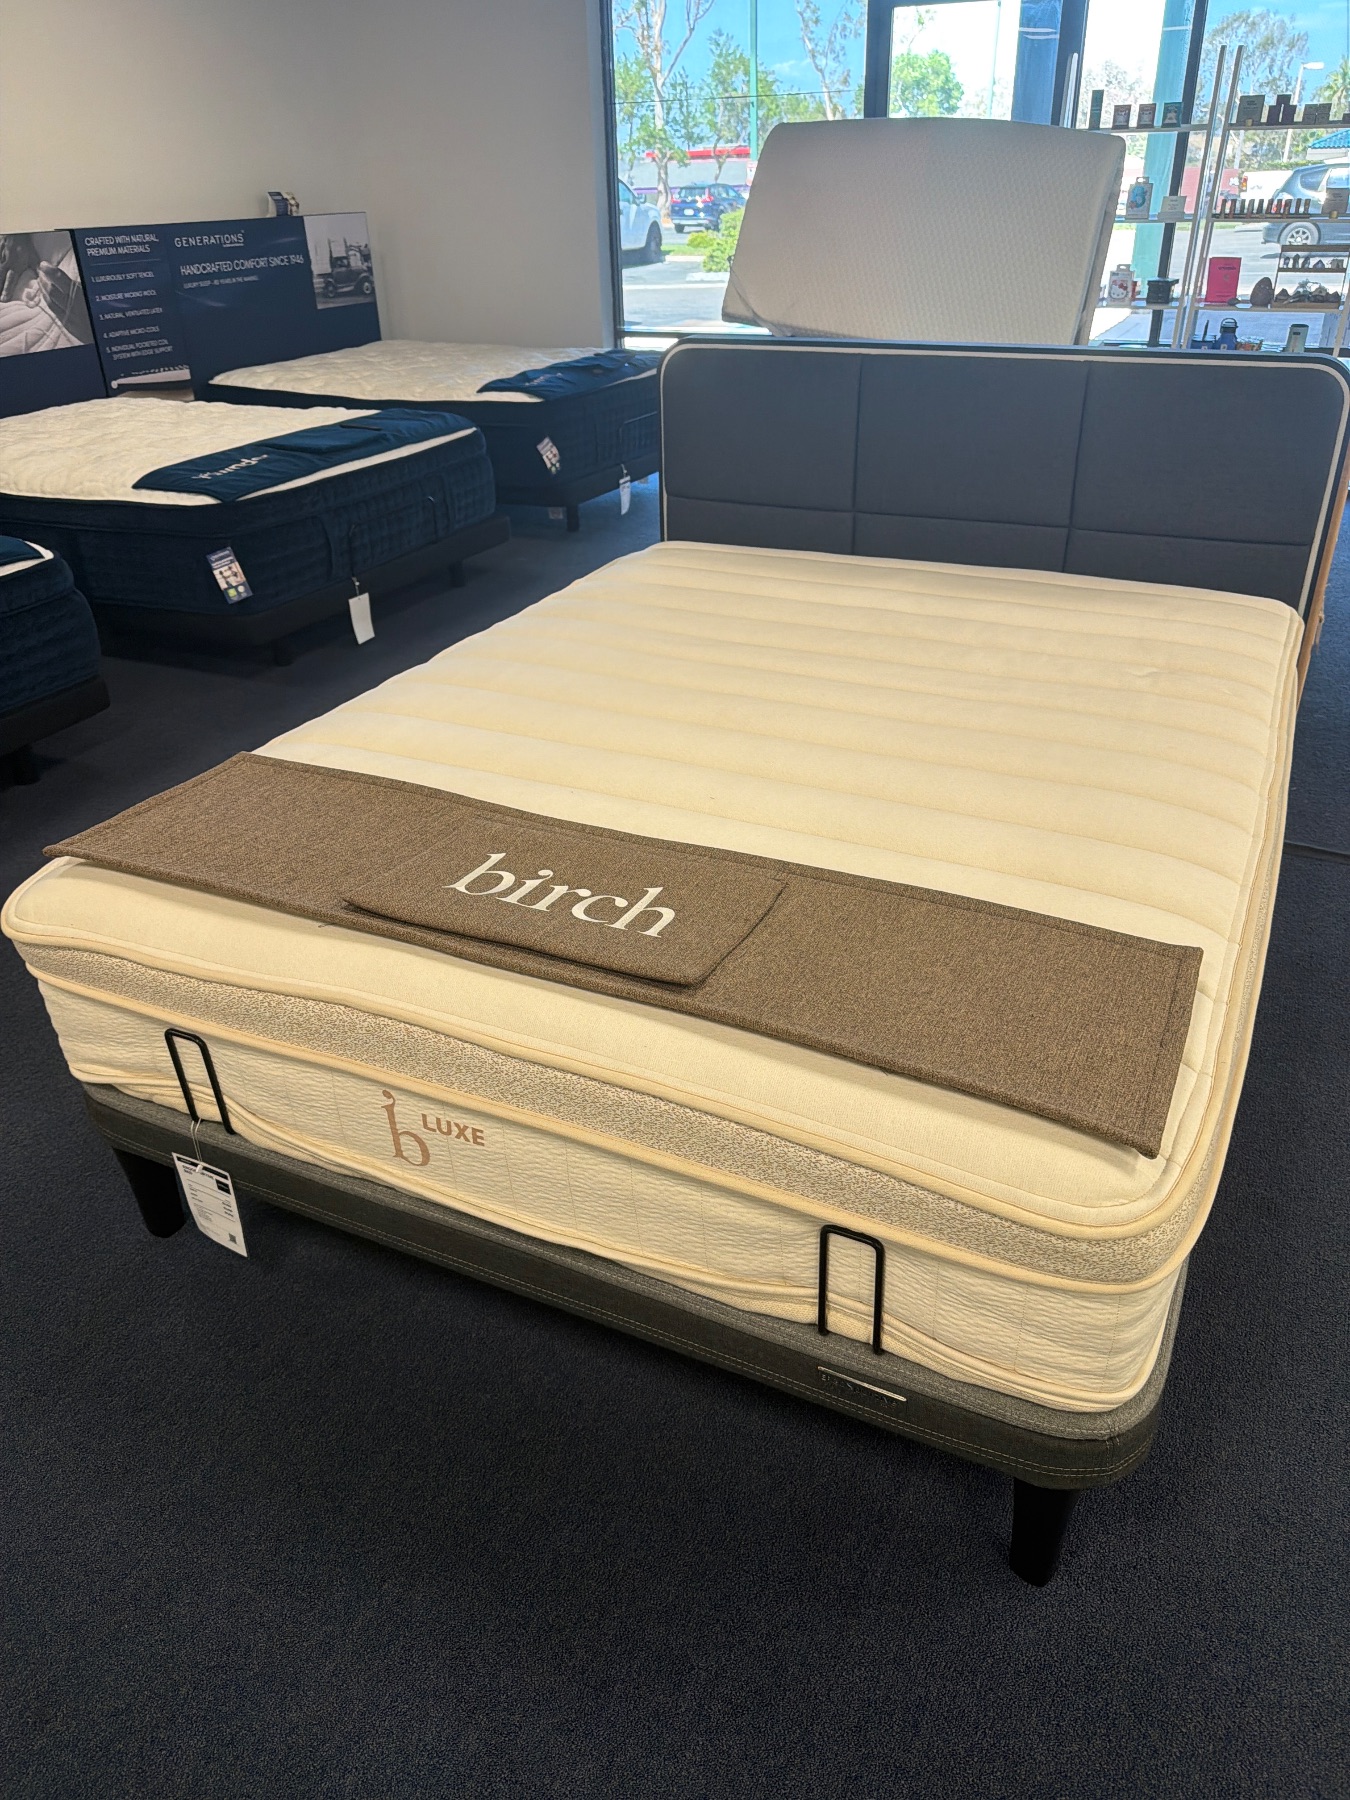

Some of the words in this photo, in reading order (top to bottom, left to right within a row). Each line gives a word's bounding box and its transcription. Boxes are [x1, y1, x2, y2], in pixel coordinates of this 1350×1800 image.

[84, 236, 115, 246] CRAFTED
[115, 235, 131, 245] WITH
[174, 233, 244, 248] GENERATIONS
[86, 246, 118, 257] PREMIUM
[118, 244, 151, 255] MATERIALS
[180, 261, 233, 276] HANDCRAFTED
[233, 257, 269, 271] COMFORT
[269, 255, 289, 268] SINCE
[289, 254, 305, 265] 1946
[441, 852, 676, 938] birch
[421, 1113, 486, 1147] LUXE
